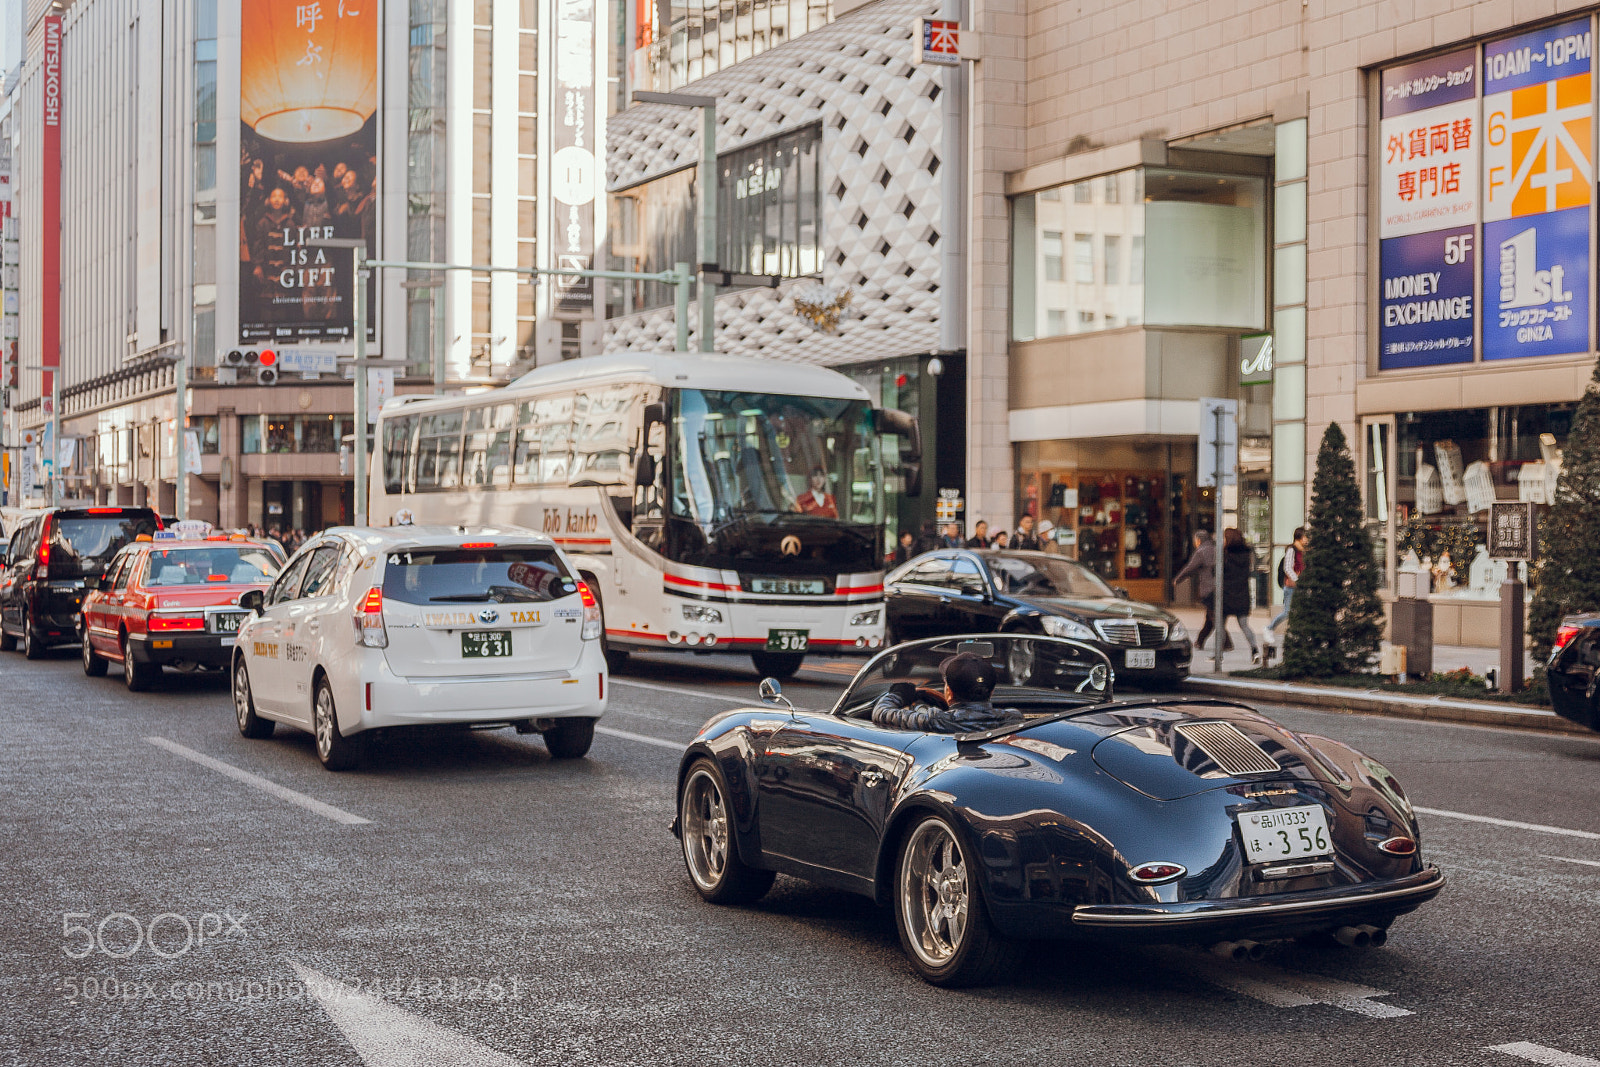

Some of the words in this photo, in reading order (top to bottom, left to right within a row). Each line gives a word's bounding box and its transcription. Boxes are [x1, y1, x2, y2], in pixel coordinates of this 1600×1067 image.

[46, 22, 60, 126] MITSUKOSHI
[1387, 117, 1472, 165] 外貨両替
[1397, 162, 1461, 202] 専門店
[291, 248, 308, 266] IS
[314, 247, 327, 265] A
[1444, 233, 1474, 265] 5F
[280, 267, 336, 289] GIFT
[1384, 271, 1441, 300] MONEY
[1384, 295, 1473, 328] EXCHANGE
[1499, 304, 1573, 328] ブックファースト
[1516, 324, 1554, 343] GINZA
[426, 612, 476, 626] IWAIDA
[510, 610, 541, 623] TAXI
[1250, 839, 1263, 853] ほ
